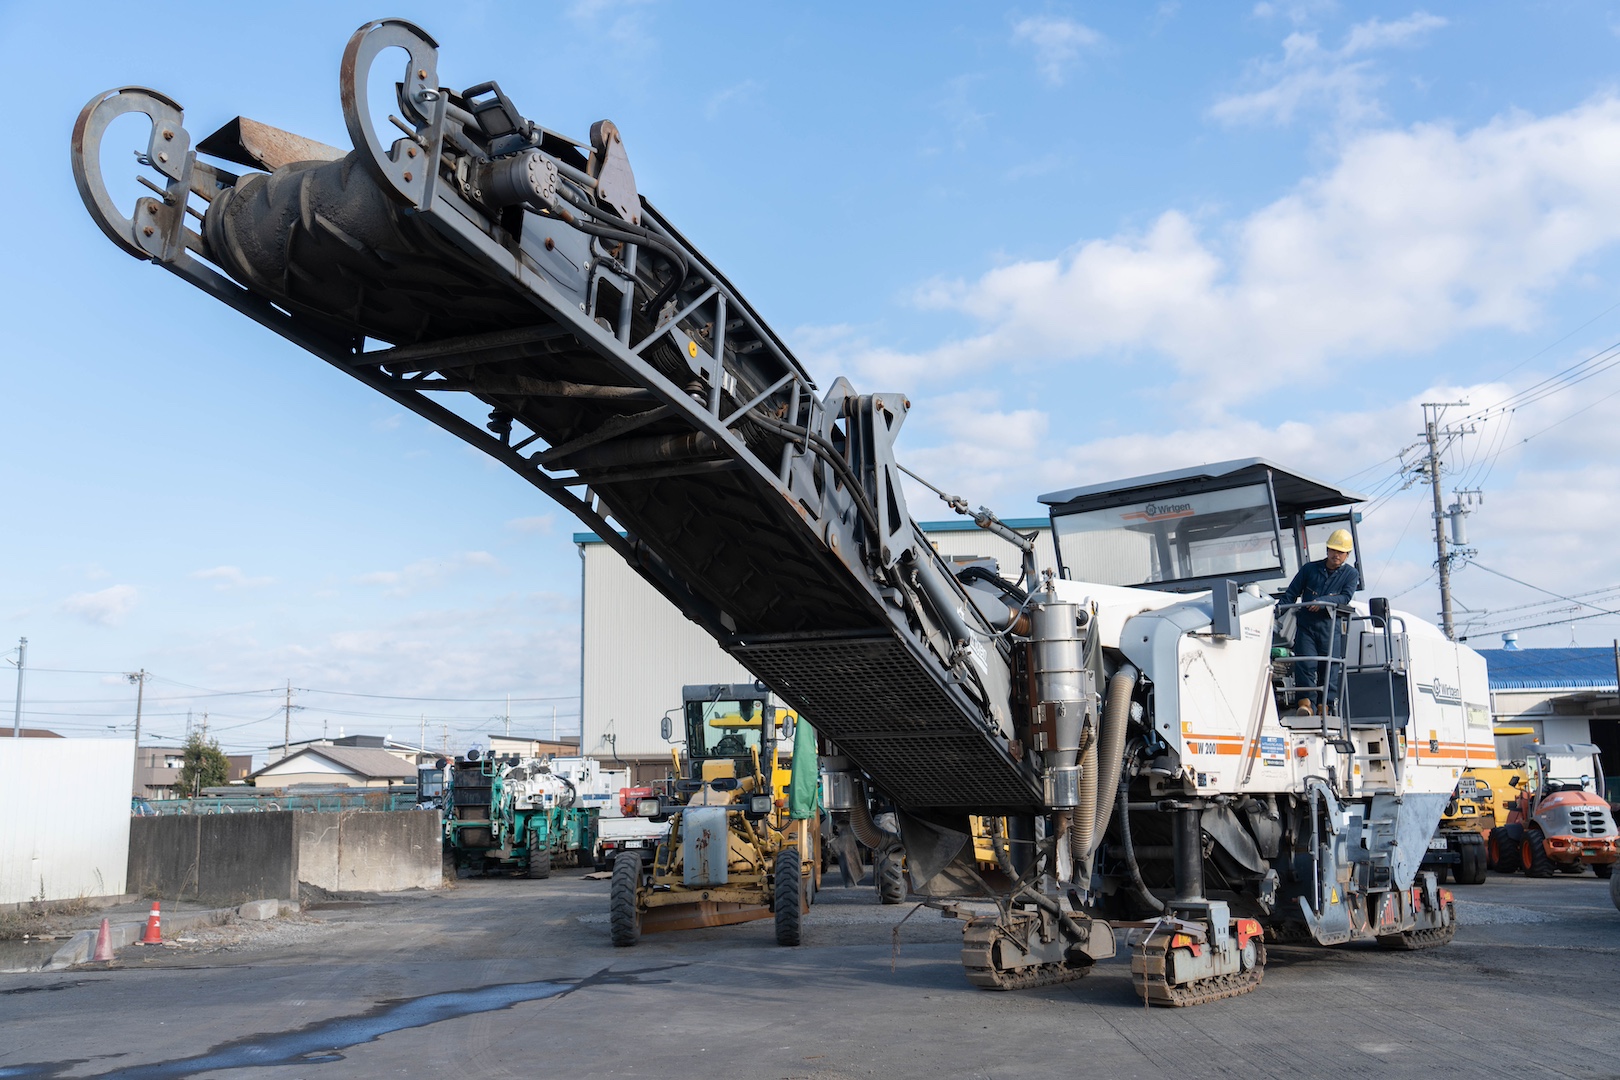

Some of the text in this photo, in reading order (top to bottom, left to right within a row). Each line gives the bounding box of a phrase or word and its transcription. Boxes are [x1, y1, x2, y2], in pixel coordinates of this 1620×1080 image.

[1157, 503, 1191, 514] Wirtgen
[1440, 683, 1461, 699] Wirtgen
[1197, 742, 1217, 755] W 200
